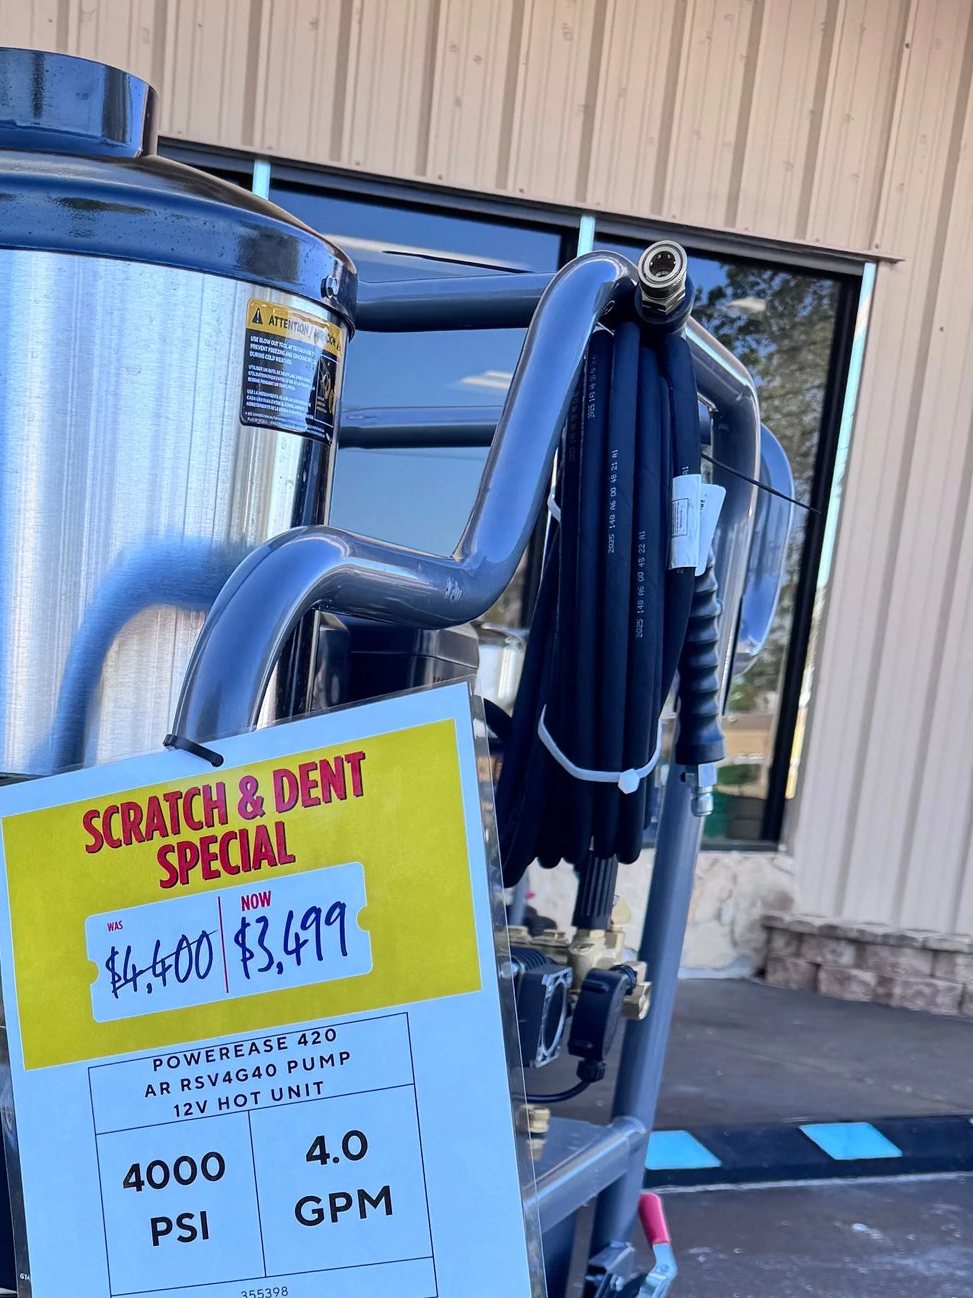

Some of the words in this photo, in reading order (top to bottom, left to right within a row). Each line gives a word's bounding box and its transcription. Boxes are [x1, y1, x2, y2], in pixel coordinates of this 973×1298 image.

[268, 315, 310, 337] ATTENTION
[607, 533, 615, 554] 2025
[636, 618, 644, 638] 2025
[82, 780, 228, 854] SCRATCH
[237, 775, 265, 821] &
[273, 750, 366, 814] DENT
[156, 820, 296, 889] SPECIAL
[241, 890, 272, 912] NOW
[107, 920, 123, 932] WAS
[234, 901, 348, 980] $3,499
[105, 930, 215, 999] $4,400
[152, 1036, 289, 1072] POWEREASE
[297, 1028, 338, 1048] 420
[144, 1081, 172, 1098] AR
[180, 1063, 278, 1092] RSV4G40
[287, 1051, 352, 1075] PUMP
[174, 1100, 209, 1118] 12V
[218, 1091, 263, 1111] HOT
[271, 1081, 325, 1102] UNIT
[305, 1129, 369, 1166] 4.0
[122, 1151, 226, 1193] 4000
[294, 1185, 394, 1227] GPM
[150, 1210, 210, 1247] PSI
